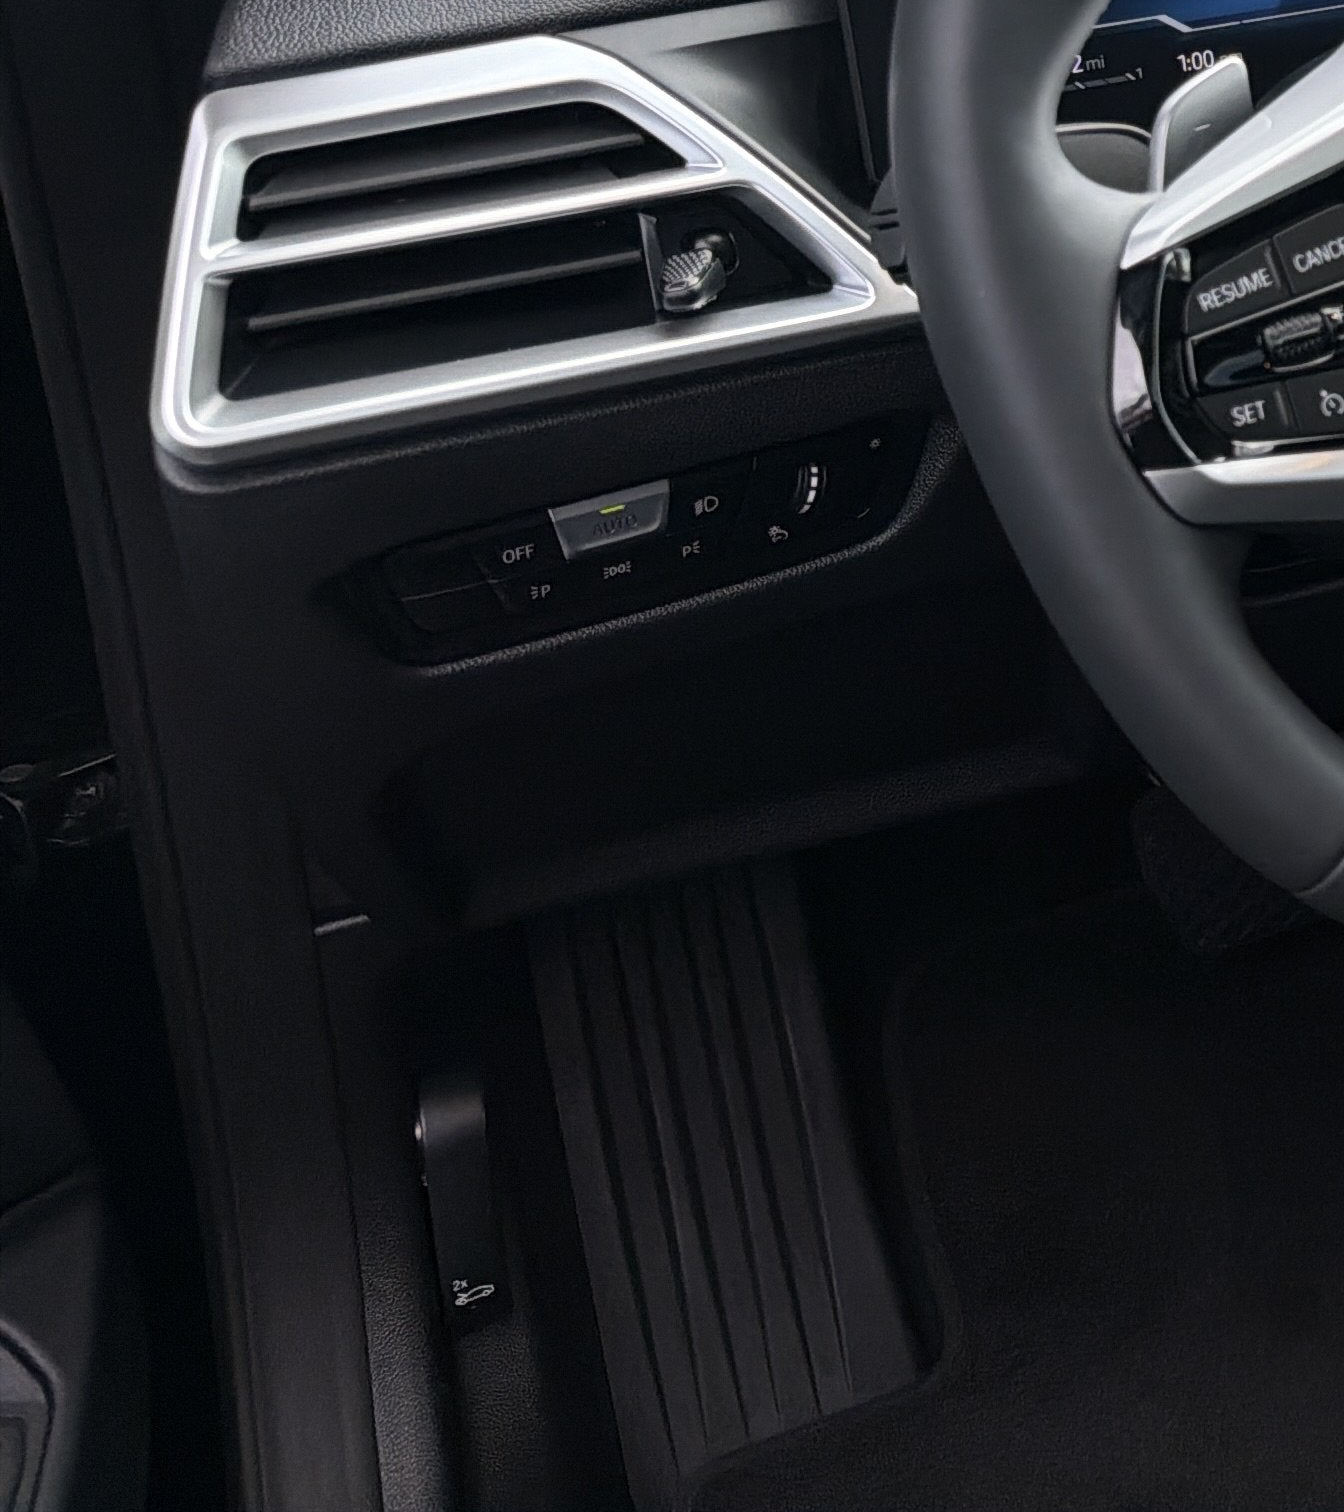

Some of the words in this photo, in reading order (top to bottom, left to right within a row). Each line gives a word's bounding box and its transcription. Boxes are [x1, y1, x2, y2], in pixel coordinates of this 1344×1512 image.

[1085, 54, 1106, 71] mi
[1176, 49, 1216, 73] 1:00
[1197, 267, 1274, 313] RESUME
[1230, 399, 1266, 428] SET
[502, 543, 535, 565] OFF
